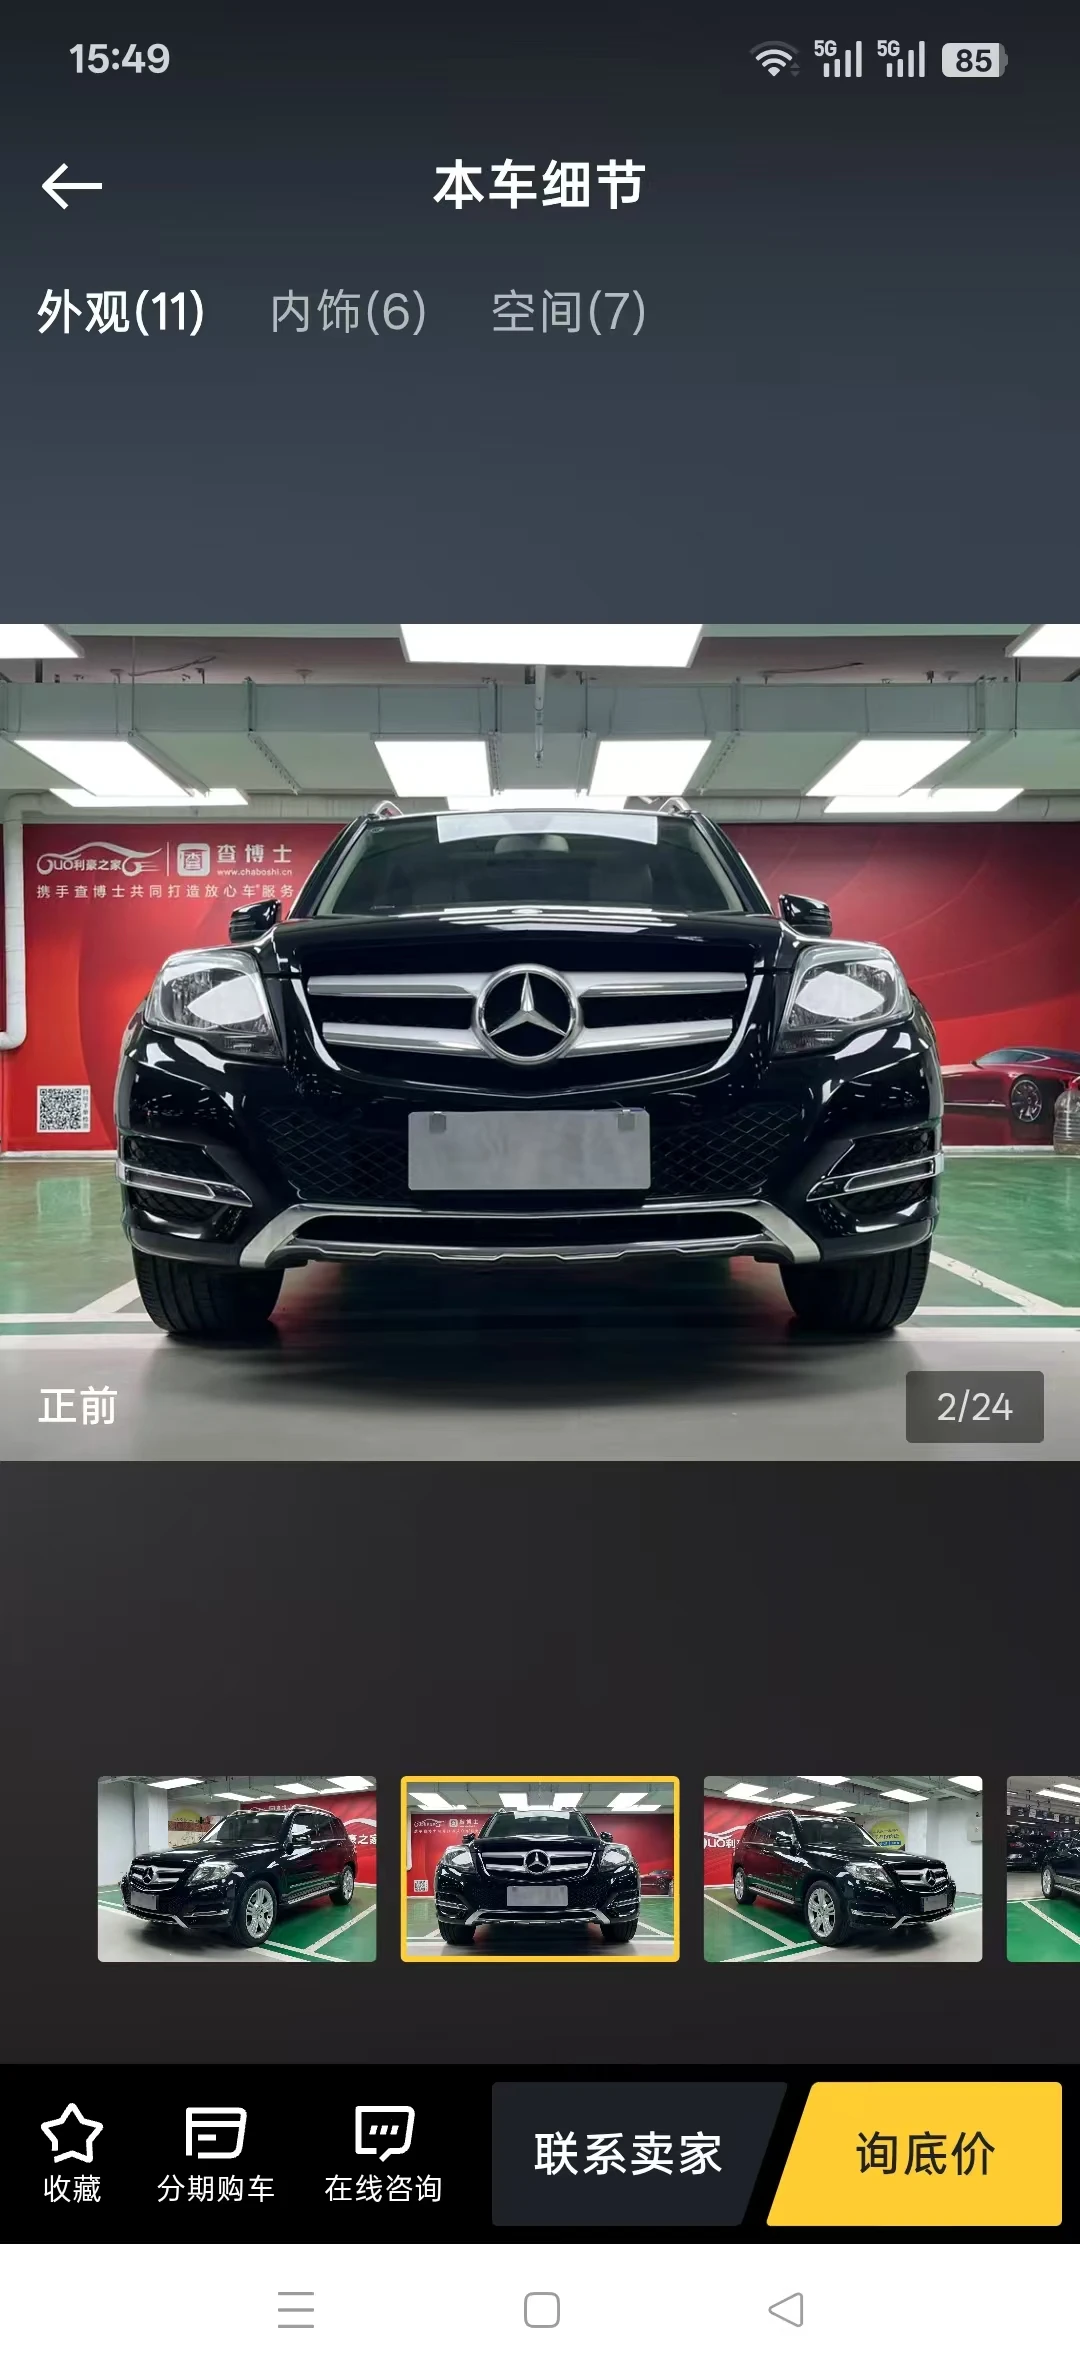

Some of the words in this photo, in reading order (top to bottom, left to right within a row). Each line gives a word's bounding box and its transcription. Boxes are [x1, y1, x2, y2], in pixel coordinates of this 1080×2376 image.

[69, 43, 170, 74] 15:49
[814, 40, 837, 57] 5G
[877, 40, 900, 57] 5G
[955, 48, 993, 73] 85
[432, 157, 646, 210] 本车细节
[36, 288, 204, 337] 外观(11)
[269, 288, 426, 337] 内饰(6)
[491, 288, 646, 337] 空间(7)
[216, 844, 293, 864] 查博士
[216, 868, 293, 876] www.chaboshi.cn
[38, 1385, 118, 1425] 正前
[937, 1388, 1014, 1423] 2/24
[534, 2129, 724, 2177] 联系卖家
[855, 2130, 997, 2178] 询底价
[43, 2173, 102, 2204] 收藏
[156, 2173, 275, 2204] 分期购车
[324, 2173, 443, 2204] 在线咨询
